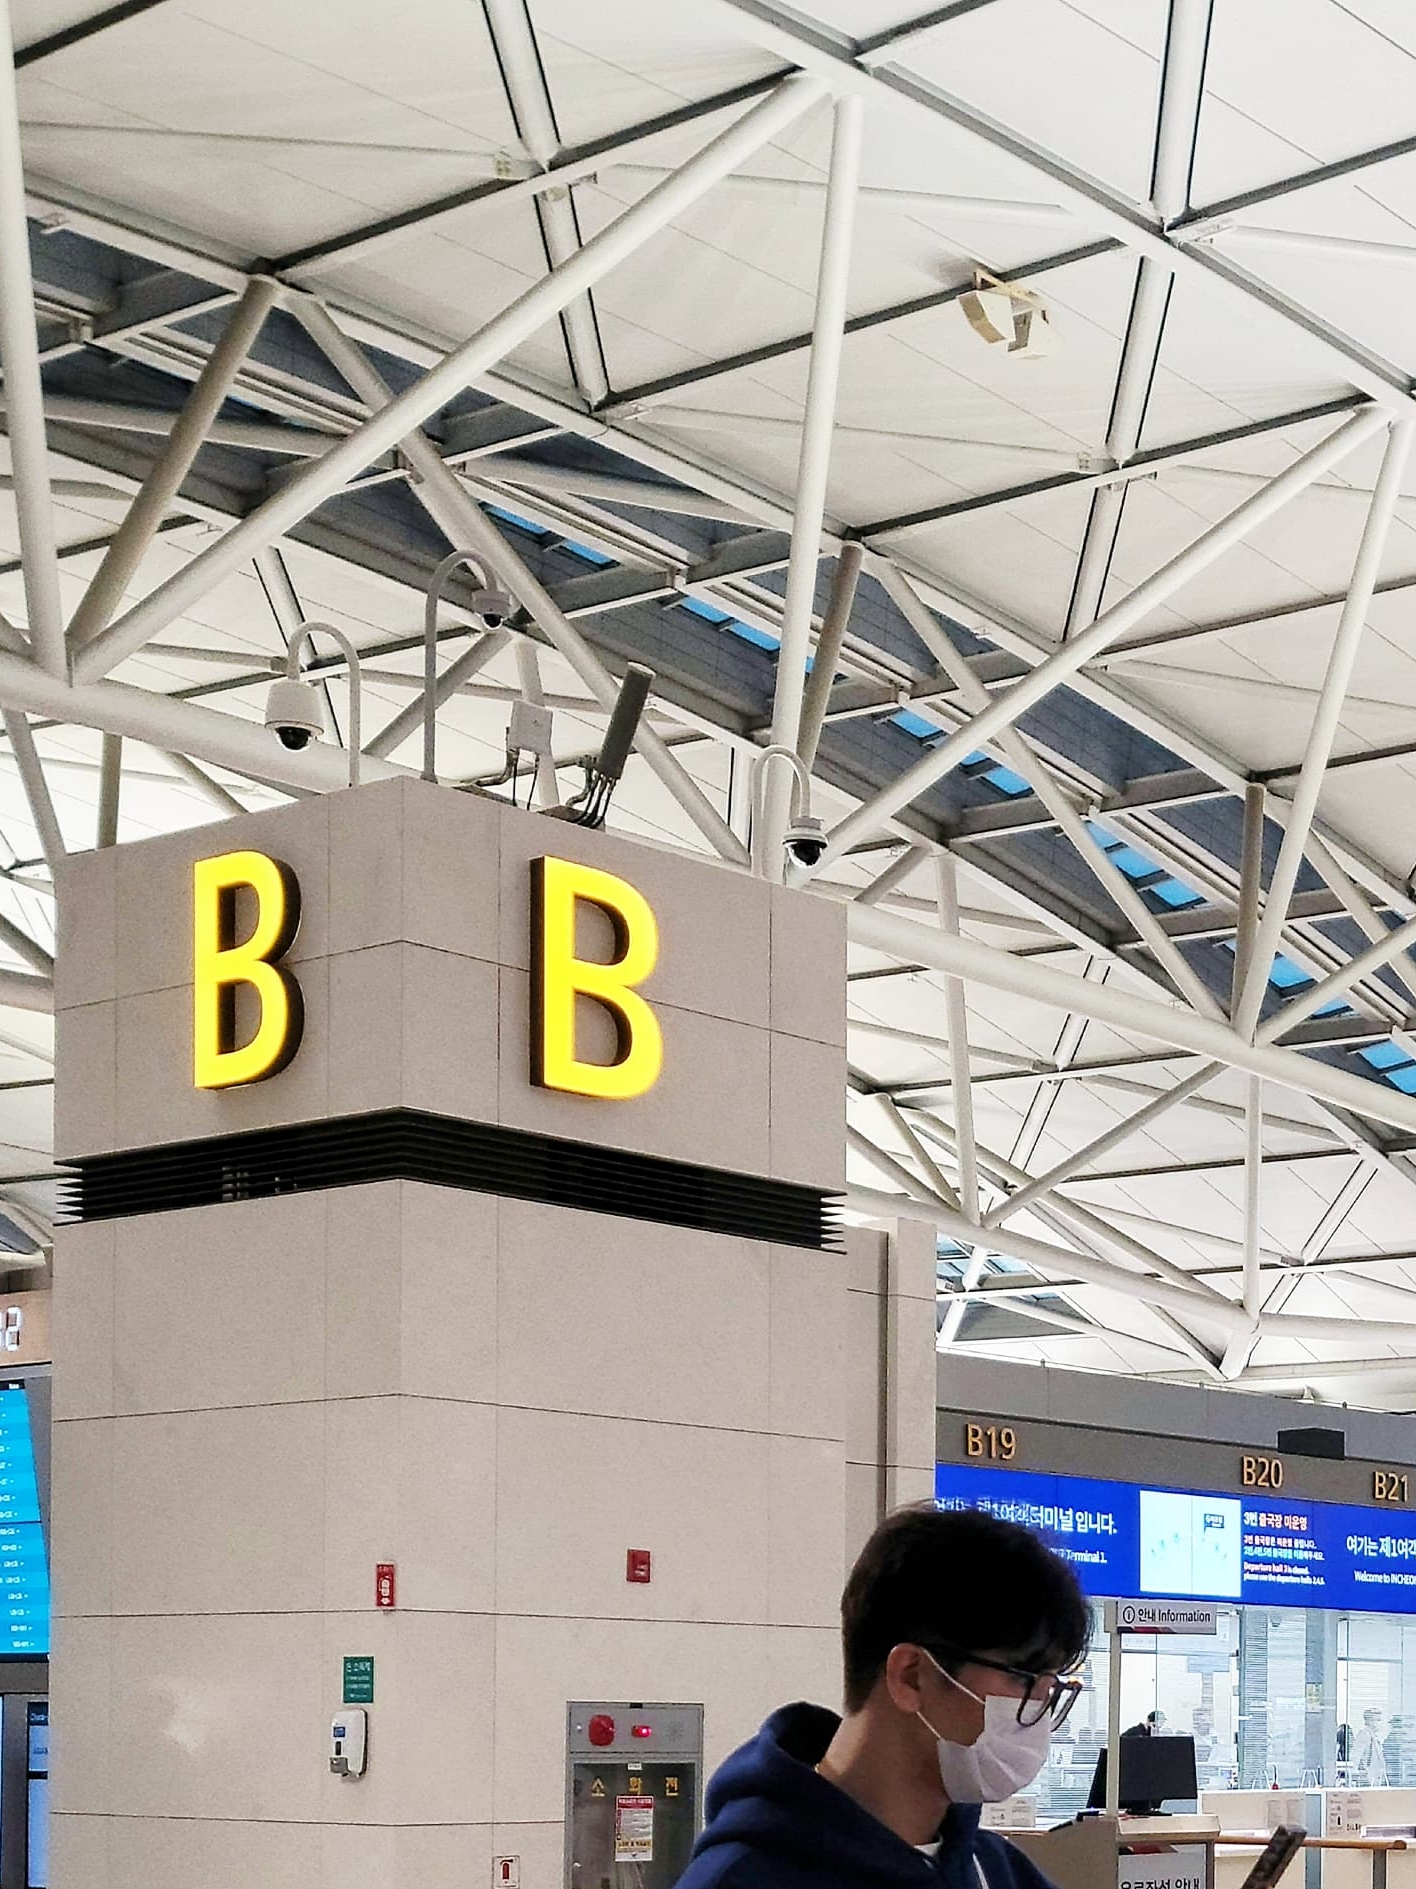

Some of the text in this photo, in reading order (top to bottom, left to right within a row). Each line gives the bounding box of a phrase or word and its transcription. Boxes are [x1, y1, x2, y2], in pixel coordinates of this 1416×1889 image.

[193, 849, 303, 1089] B
[530, 855, 664, 1100] B
[966, 1423, 1017, 1461] B19
[1241, 1455, 1284, 1488] B20
[1373, 1471, 1409, 1502] B21
[1075, 1511, 1117, 1535] 입니다.
[1346, 1535, 1378, 1556] 여기는
[1138, 1607, 1156, 1622] 안내
[1158, 1608, 1211, 1622] Information
